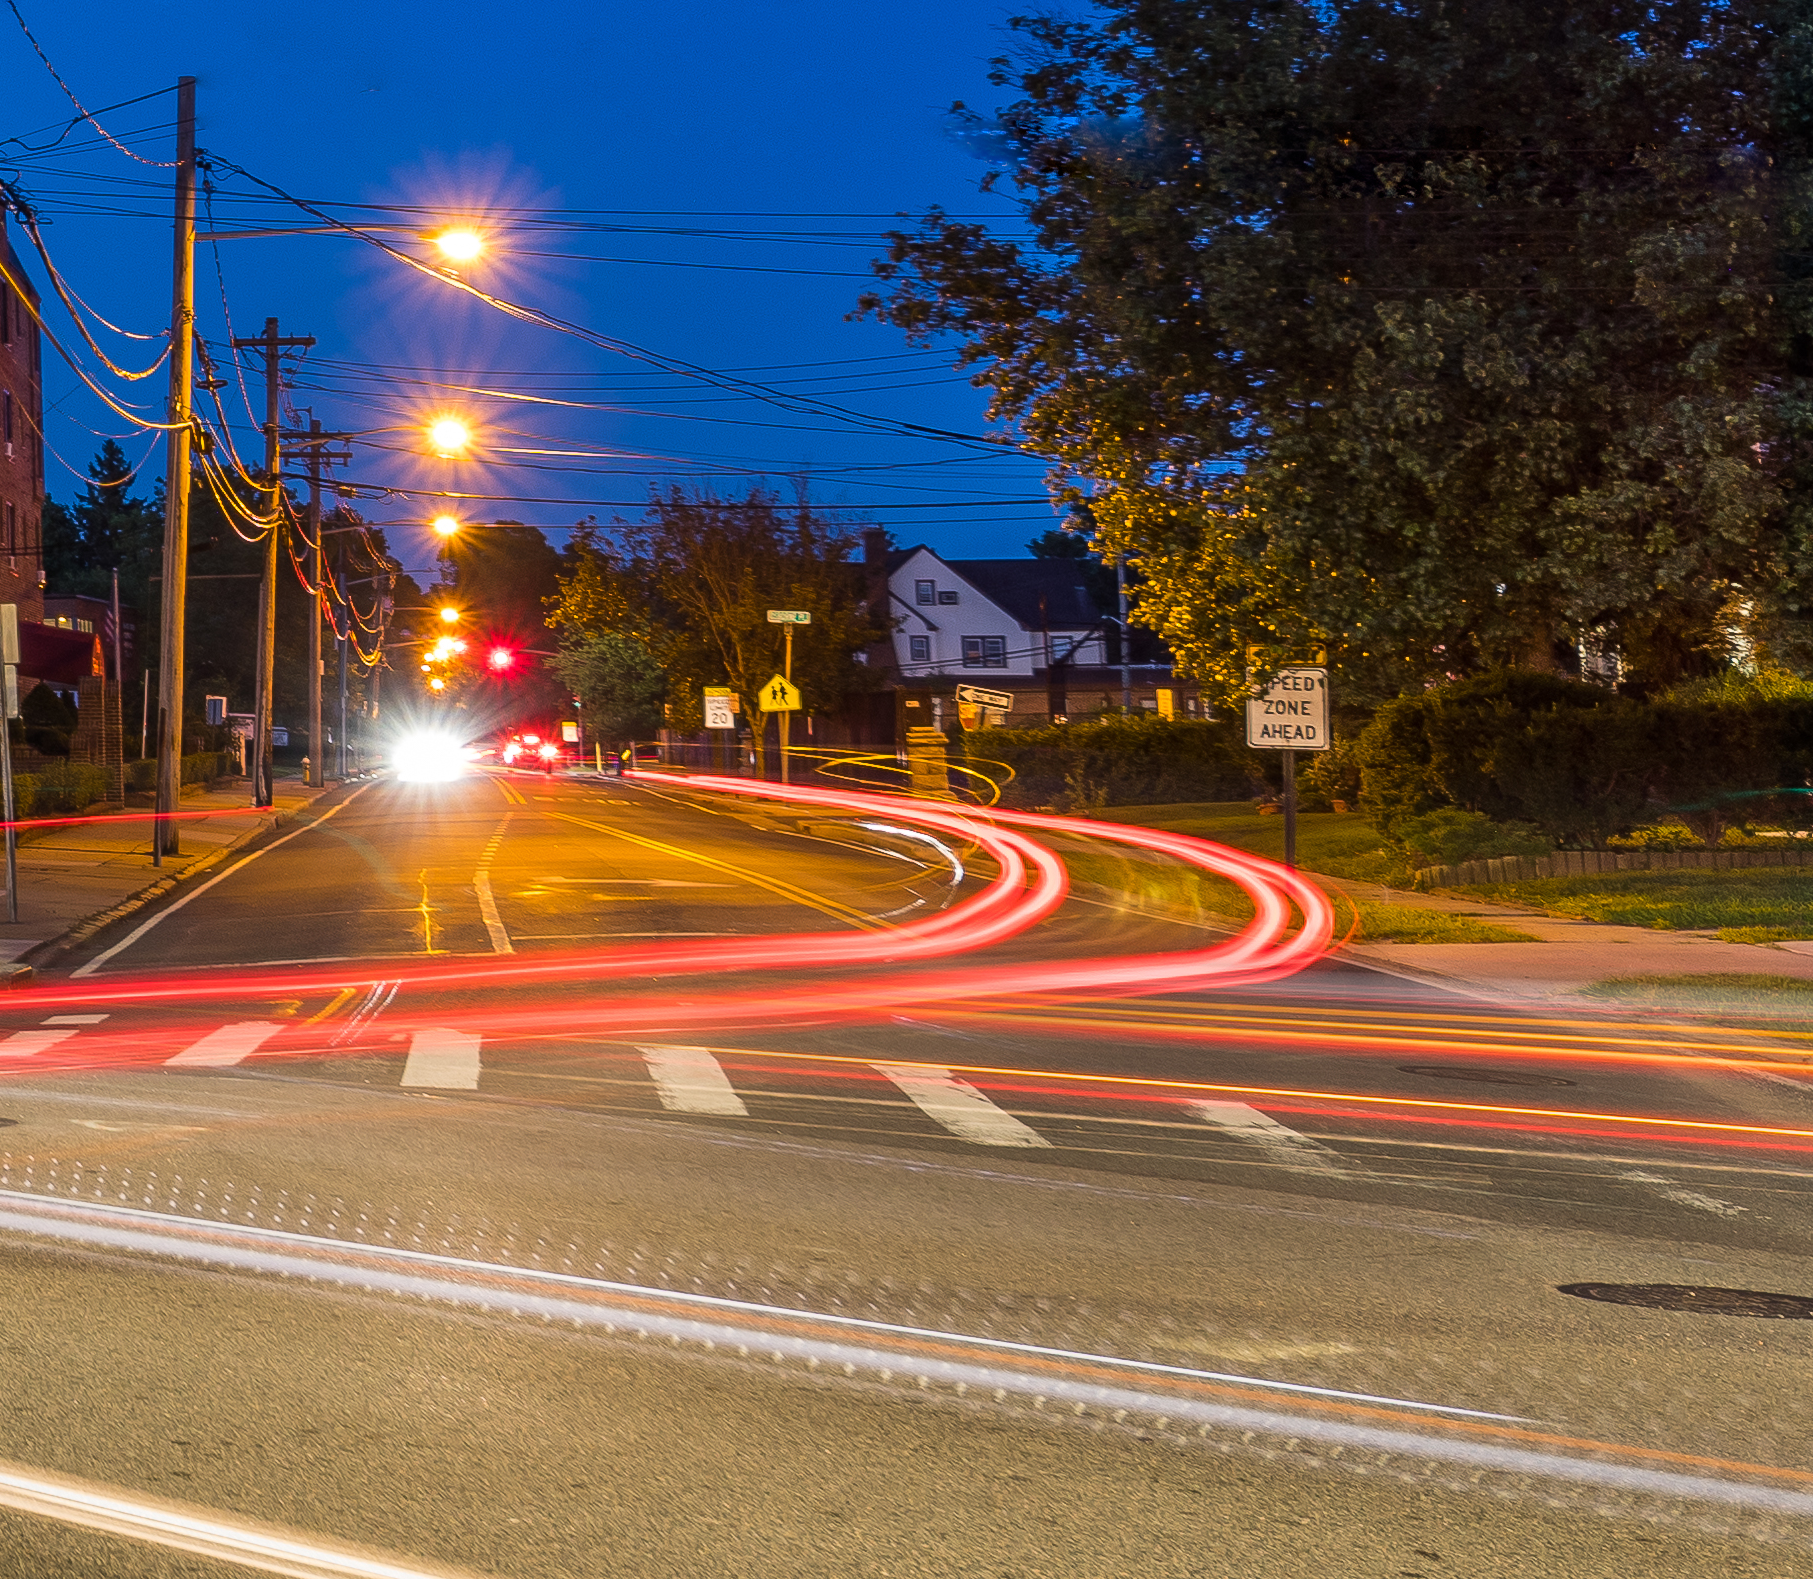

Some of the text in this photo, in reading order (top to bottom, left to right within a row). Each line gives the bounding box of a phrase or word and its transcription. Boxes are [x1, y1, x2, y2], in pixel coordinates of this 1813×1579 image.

[1262, 676, 1314, 691] PEED
[1263, 700, 1311, 715] ZONE
[712, 713, 728, 725] 20
[1260, 724, 1316, 740] AHEAD
